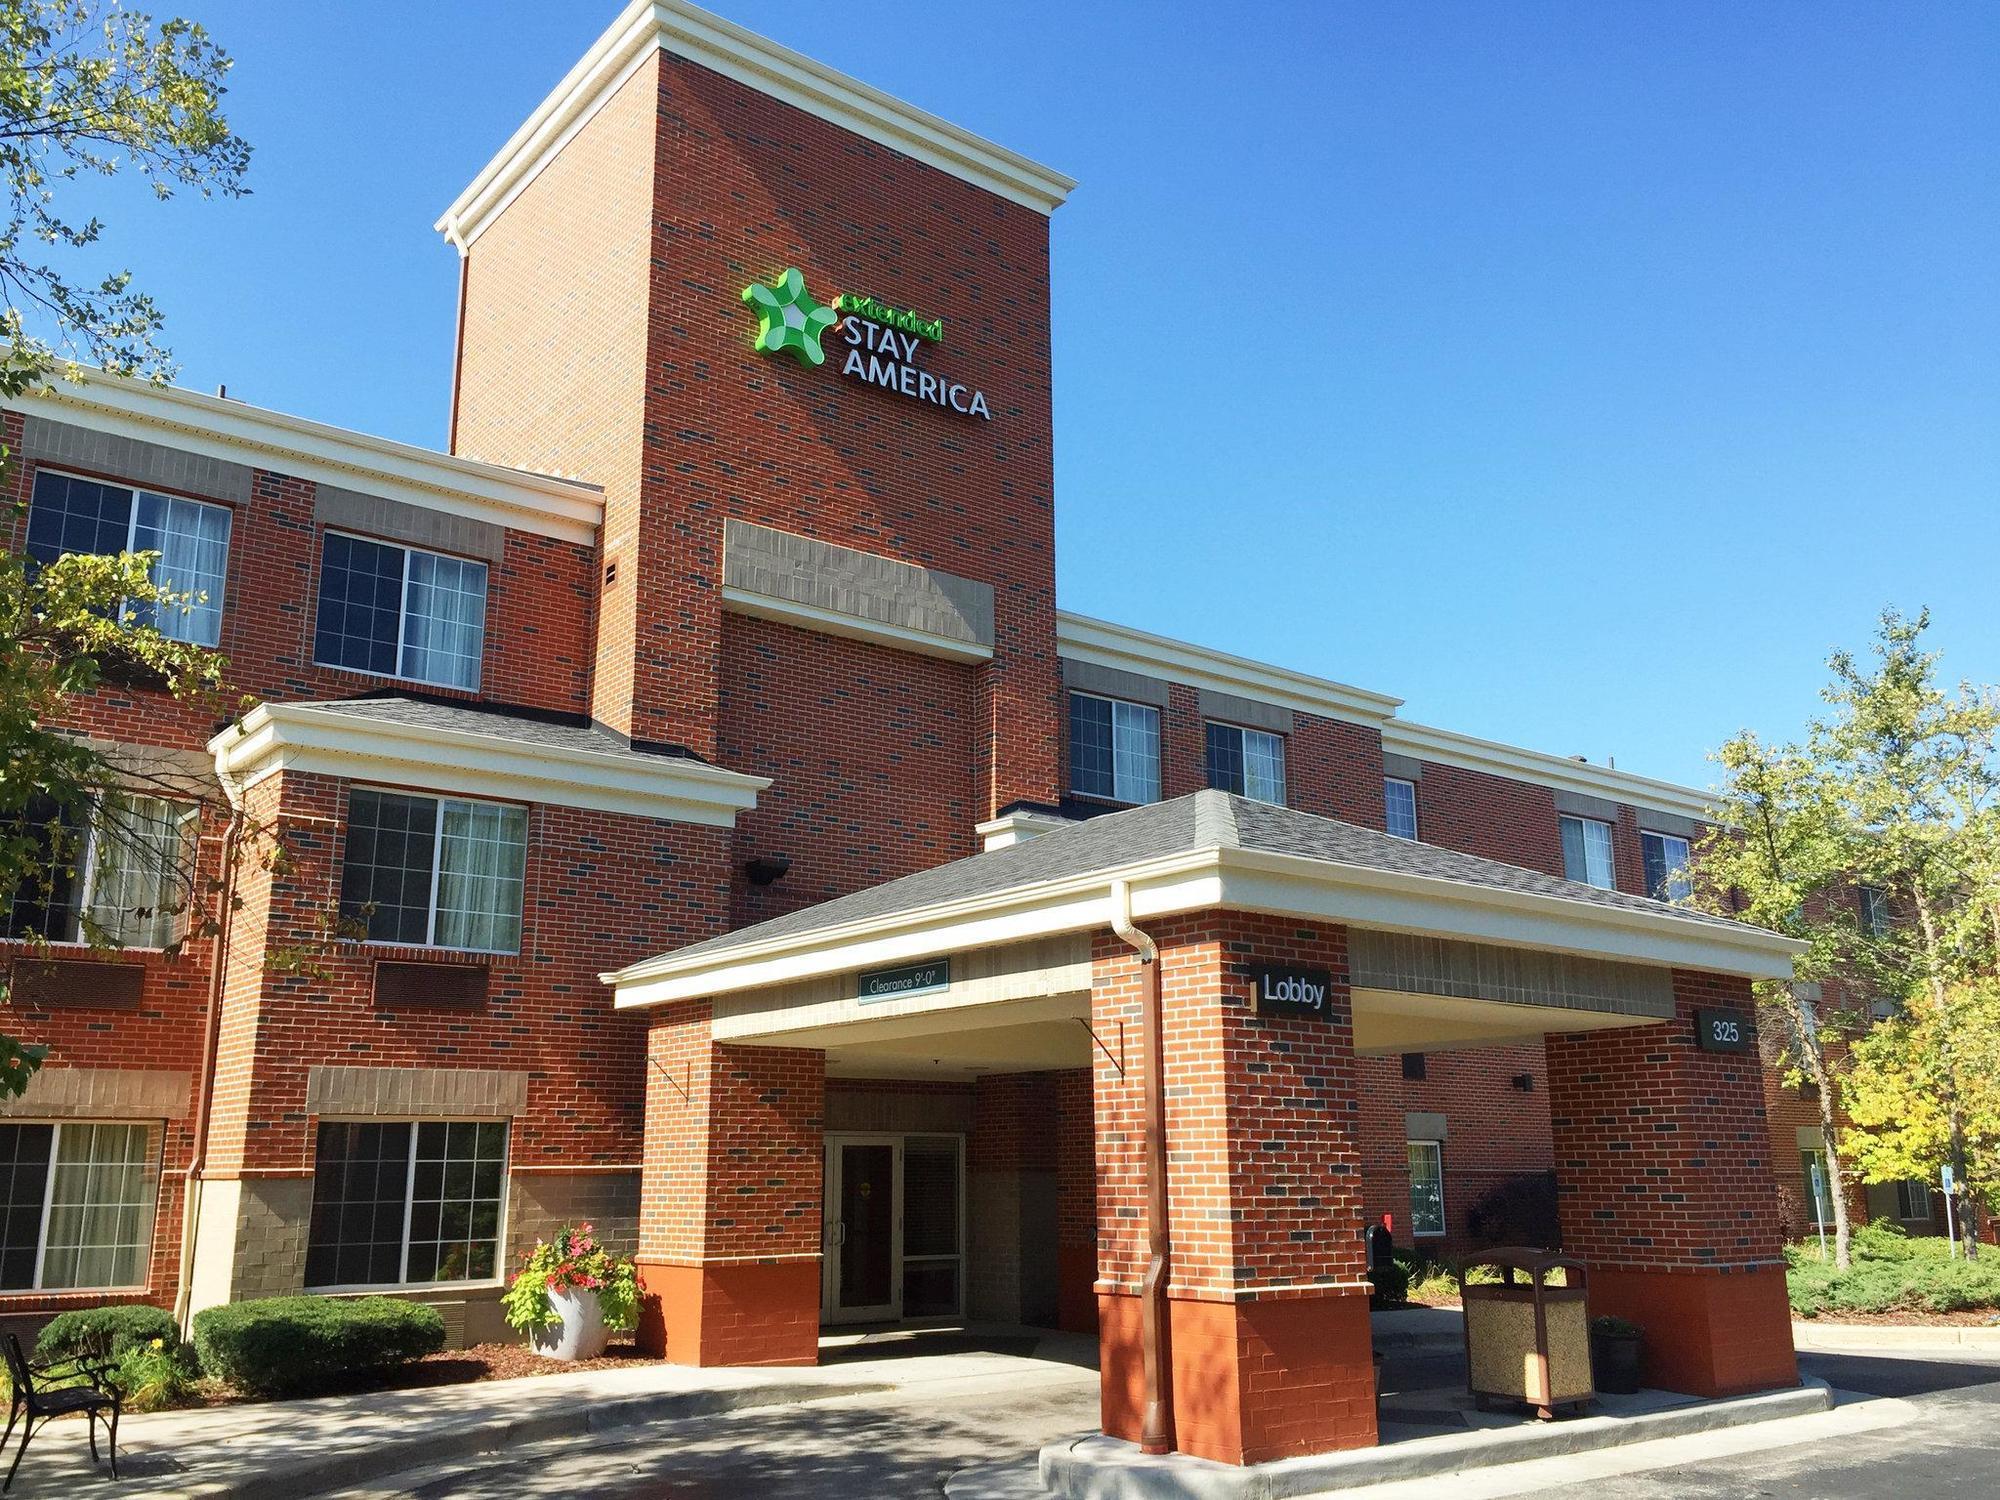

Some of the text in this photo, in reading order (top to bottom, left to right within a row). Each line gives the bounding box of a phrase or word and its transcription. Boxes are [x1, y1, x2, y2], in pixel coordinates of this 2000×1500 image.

[839, 293, 943, 341] extended
[844, 316, 919, 363] STAY
[843, 350, 991, 420] AMERICA
[870, 978, 912, 993] Clearance
[1263, 973, 1325, 1010] Lobby
[1713, 1021, 1739, 1042] 325
